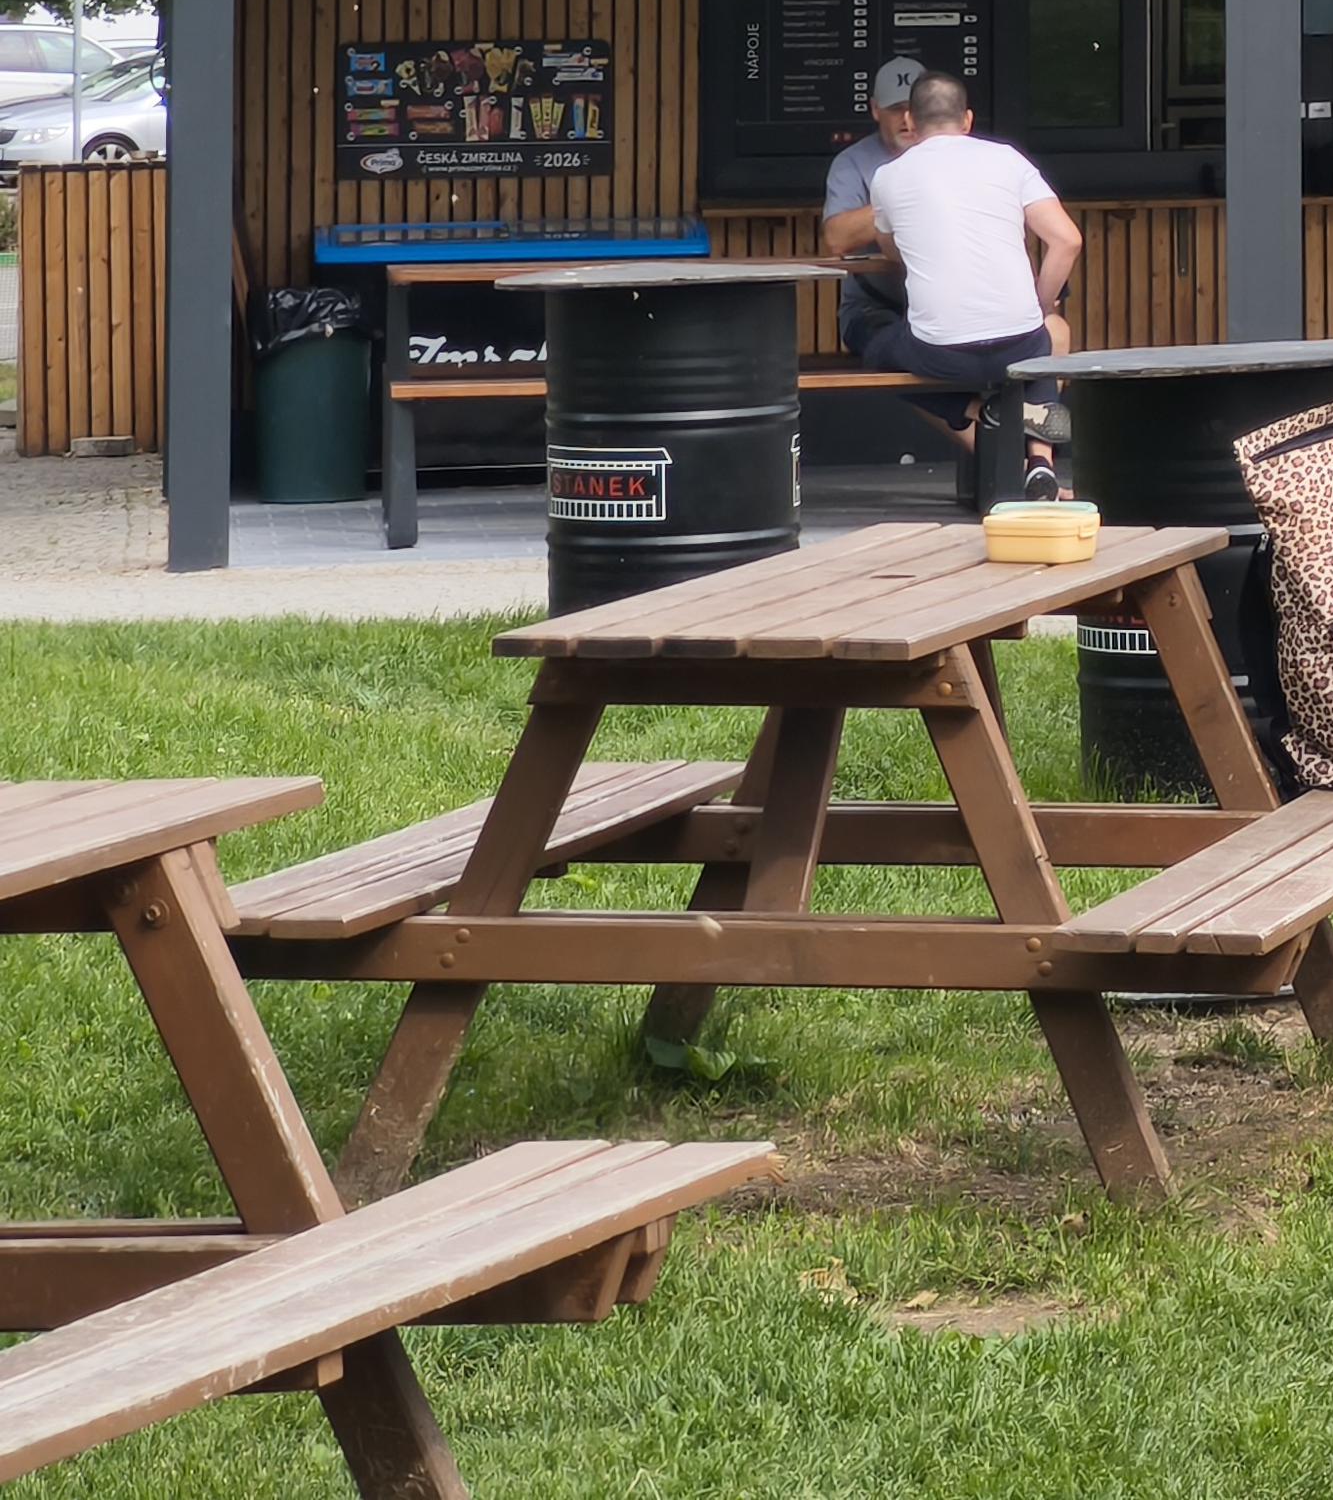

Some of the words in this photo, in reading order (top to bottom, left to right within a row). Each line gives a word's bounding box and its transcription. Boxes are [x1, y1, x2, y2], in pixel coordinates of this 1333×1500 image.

[744, 22, 760, 79] NÁPOJE
[417, 149, 458, 165] ČESKÁ
[461, 151, 524, 165] ZMRZLINA
[543, 152, 582, 168] 2026
